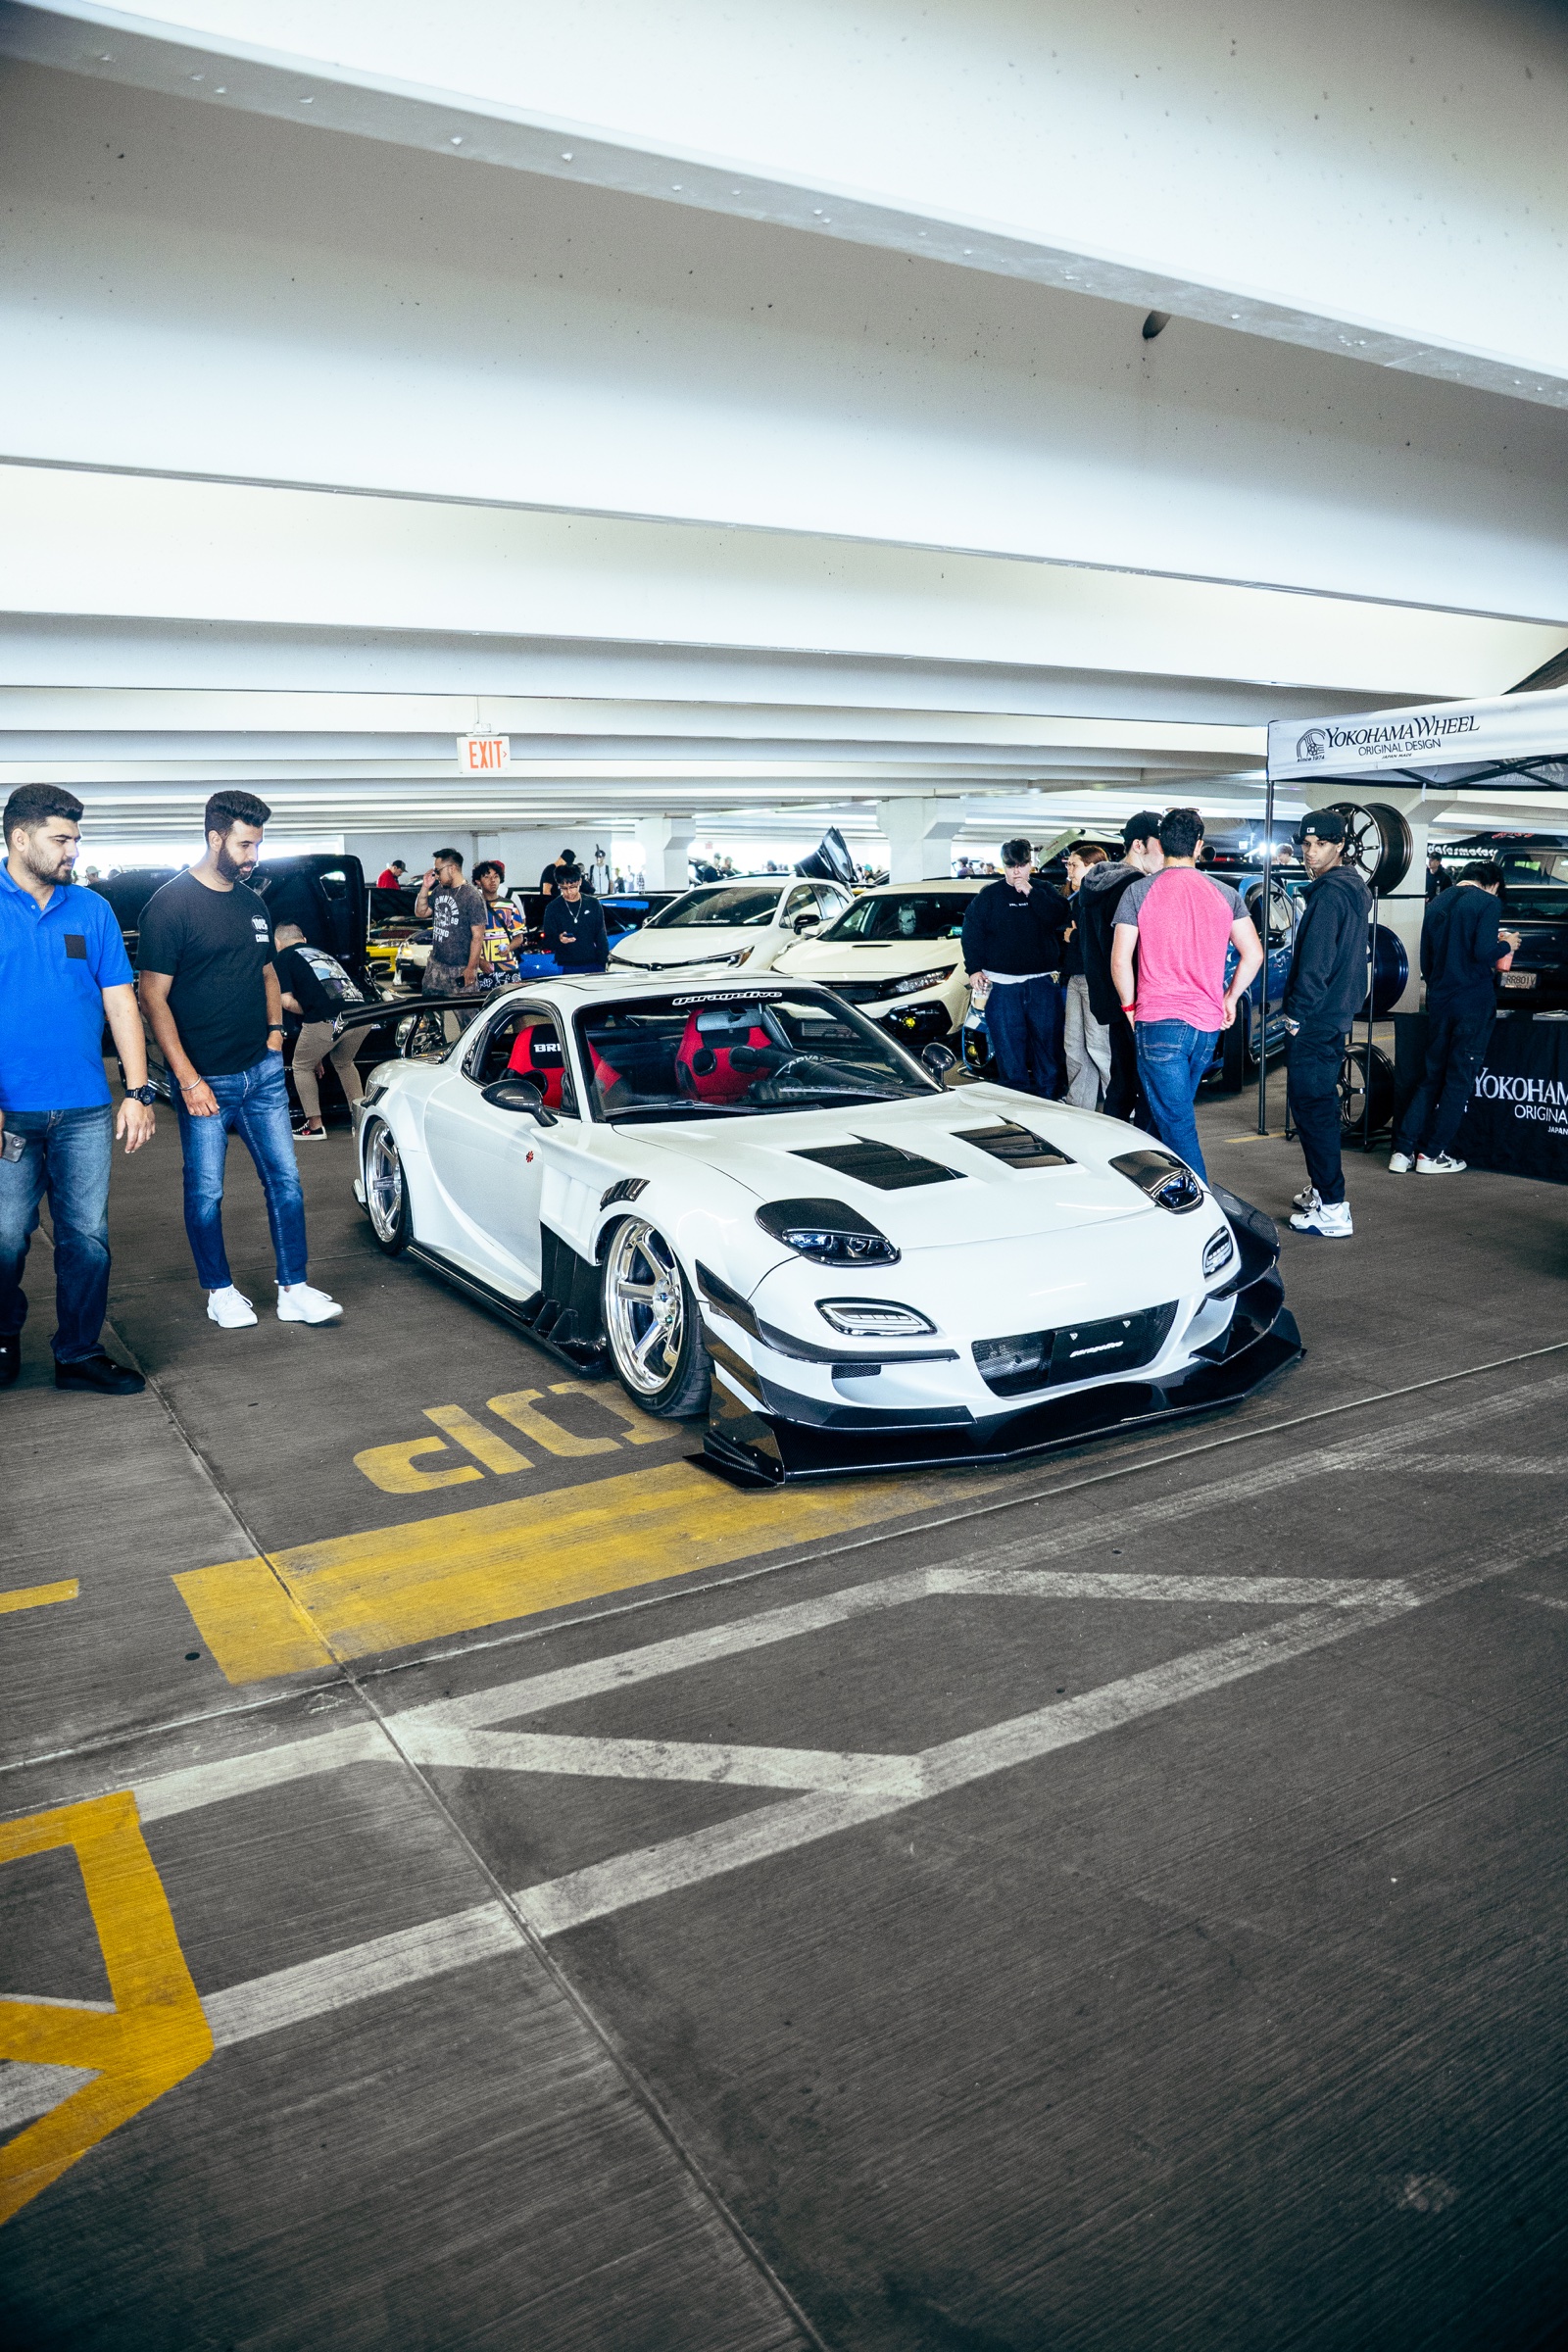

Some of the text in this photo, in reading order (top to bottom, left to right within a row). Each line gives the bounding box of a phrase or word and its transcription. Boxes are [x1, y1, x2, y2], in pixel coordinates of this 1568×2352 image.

[1325, 714, 1481, 748] YOKOHAMA WHEEL
[468, 740, 503, 769] EXIT
[1358, 738, 1442, 757] ORIGINAL DESIGN
[672, 991, 783, 1006] garagefive
